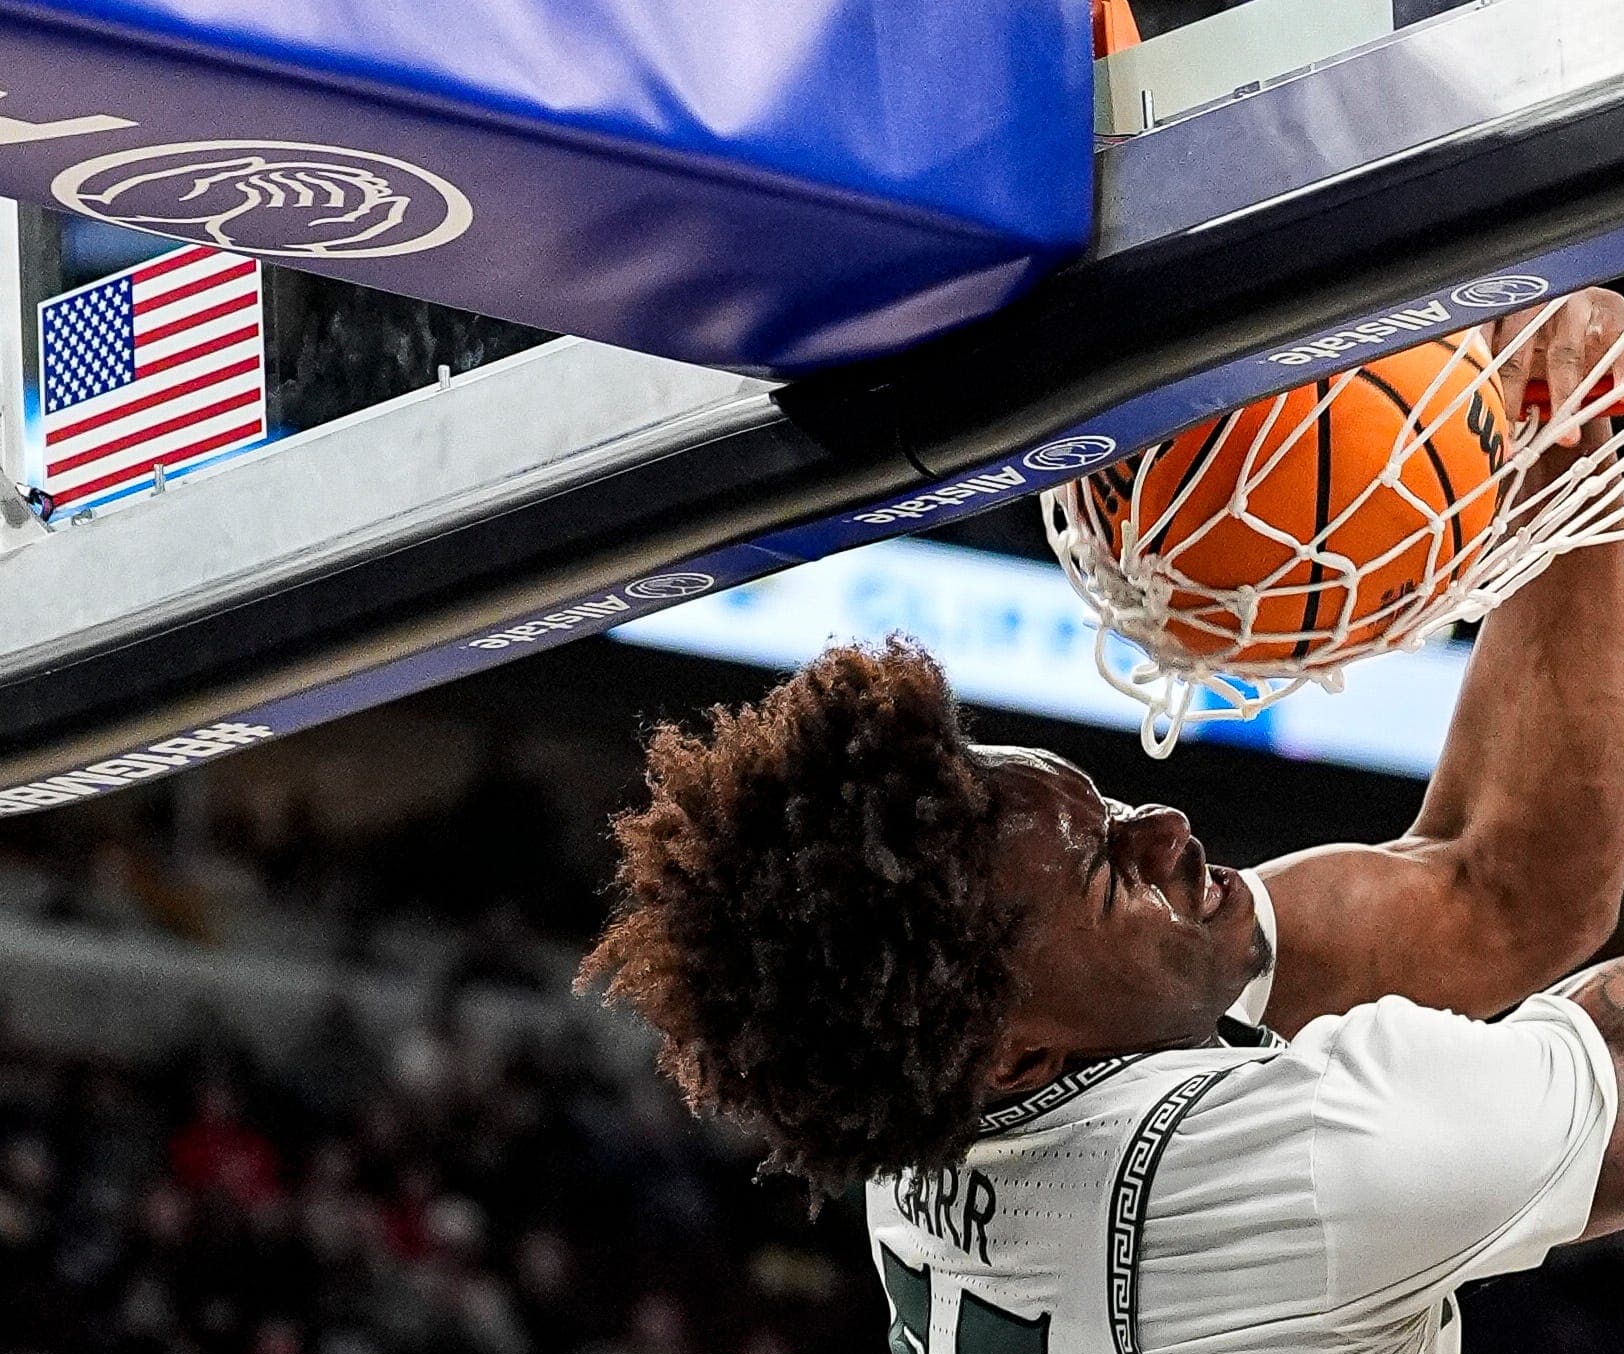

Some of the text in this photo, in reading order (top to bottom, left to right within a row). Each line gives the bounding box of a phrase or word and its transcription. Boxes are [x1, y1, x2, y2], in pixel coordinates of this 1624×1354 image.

[1268, 299, 1452, 366] Allstate
[853, 465, 1028, 524] Allstate
[469, 594, 631, 649] Allstate
[0, 722, 275, 818] #B1GMB
